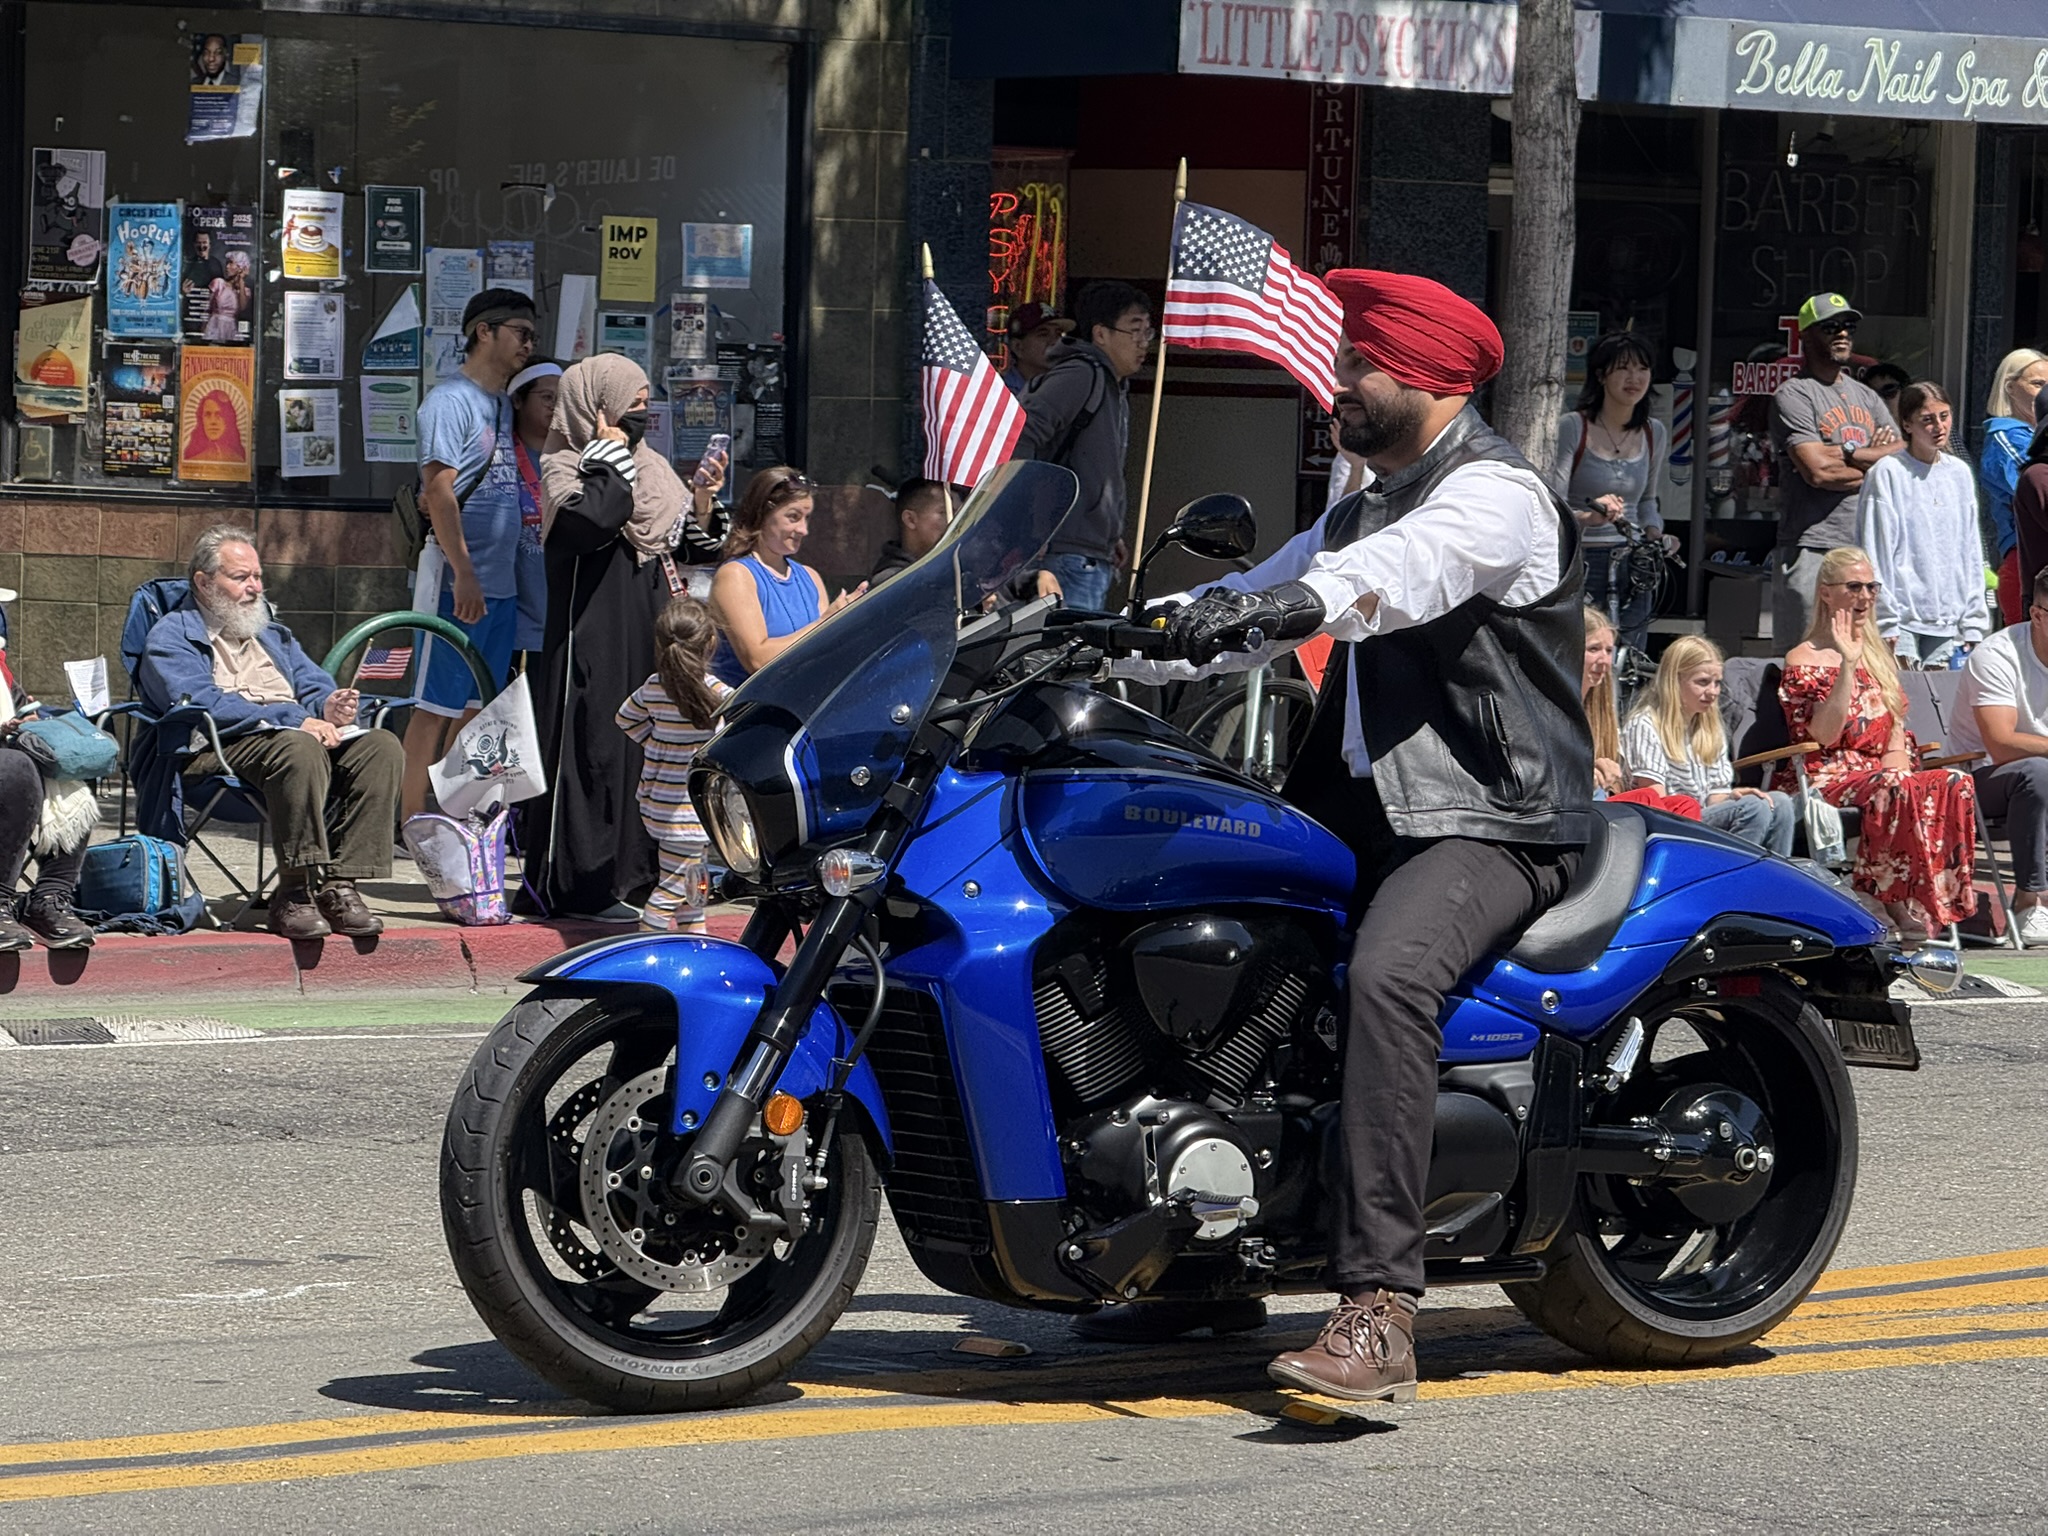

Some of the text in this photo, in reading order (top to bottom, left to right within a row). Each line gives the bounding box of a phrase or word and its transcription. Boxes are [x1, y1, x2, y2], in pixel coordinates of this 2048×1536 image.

[1197, 2, 1323, 73] LITTLE
[1735, 29, 2048, 118] Bella Nail Spa &
[1721, 168, 1921, 237] BARBER
[192, 217, 227, 228] OPERA
[609, 224, 648, 243] IMP
[608, 246, 642, 260] ROV
[1752, 246, 1889, 311] SHOP
[1819, 405, 1848, 438] NEW
[1124, 804, 1262, 838] BOULEVARD
